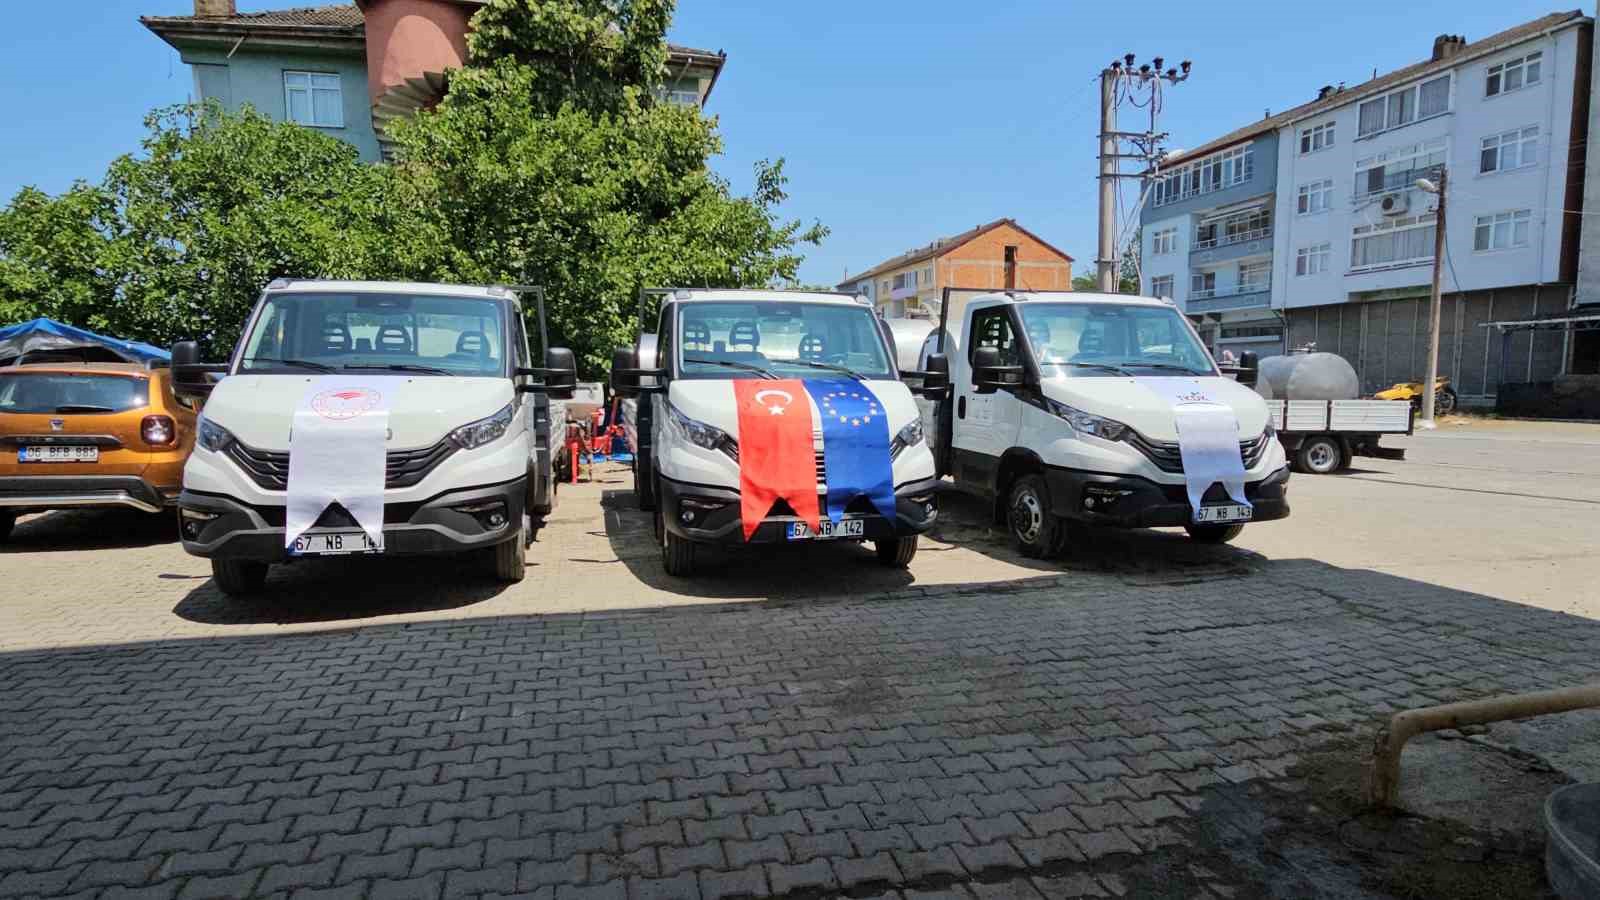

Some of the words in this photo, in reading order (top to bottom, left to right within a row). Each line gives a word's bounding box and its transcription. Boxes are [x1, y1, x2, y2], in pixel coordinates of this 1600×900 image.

[28, 447, 41, 457] 06
[1199, 508, 1208, 520] 67
[1217, 507, 1227, 519] NB
[795, 522, 807, 536] 67
[844, 521, 862, 534] 142
[296, 536, 311, 551] 67
[326, 535, 343, 550] NB
